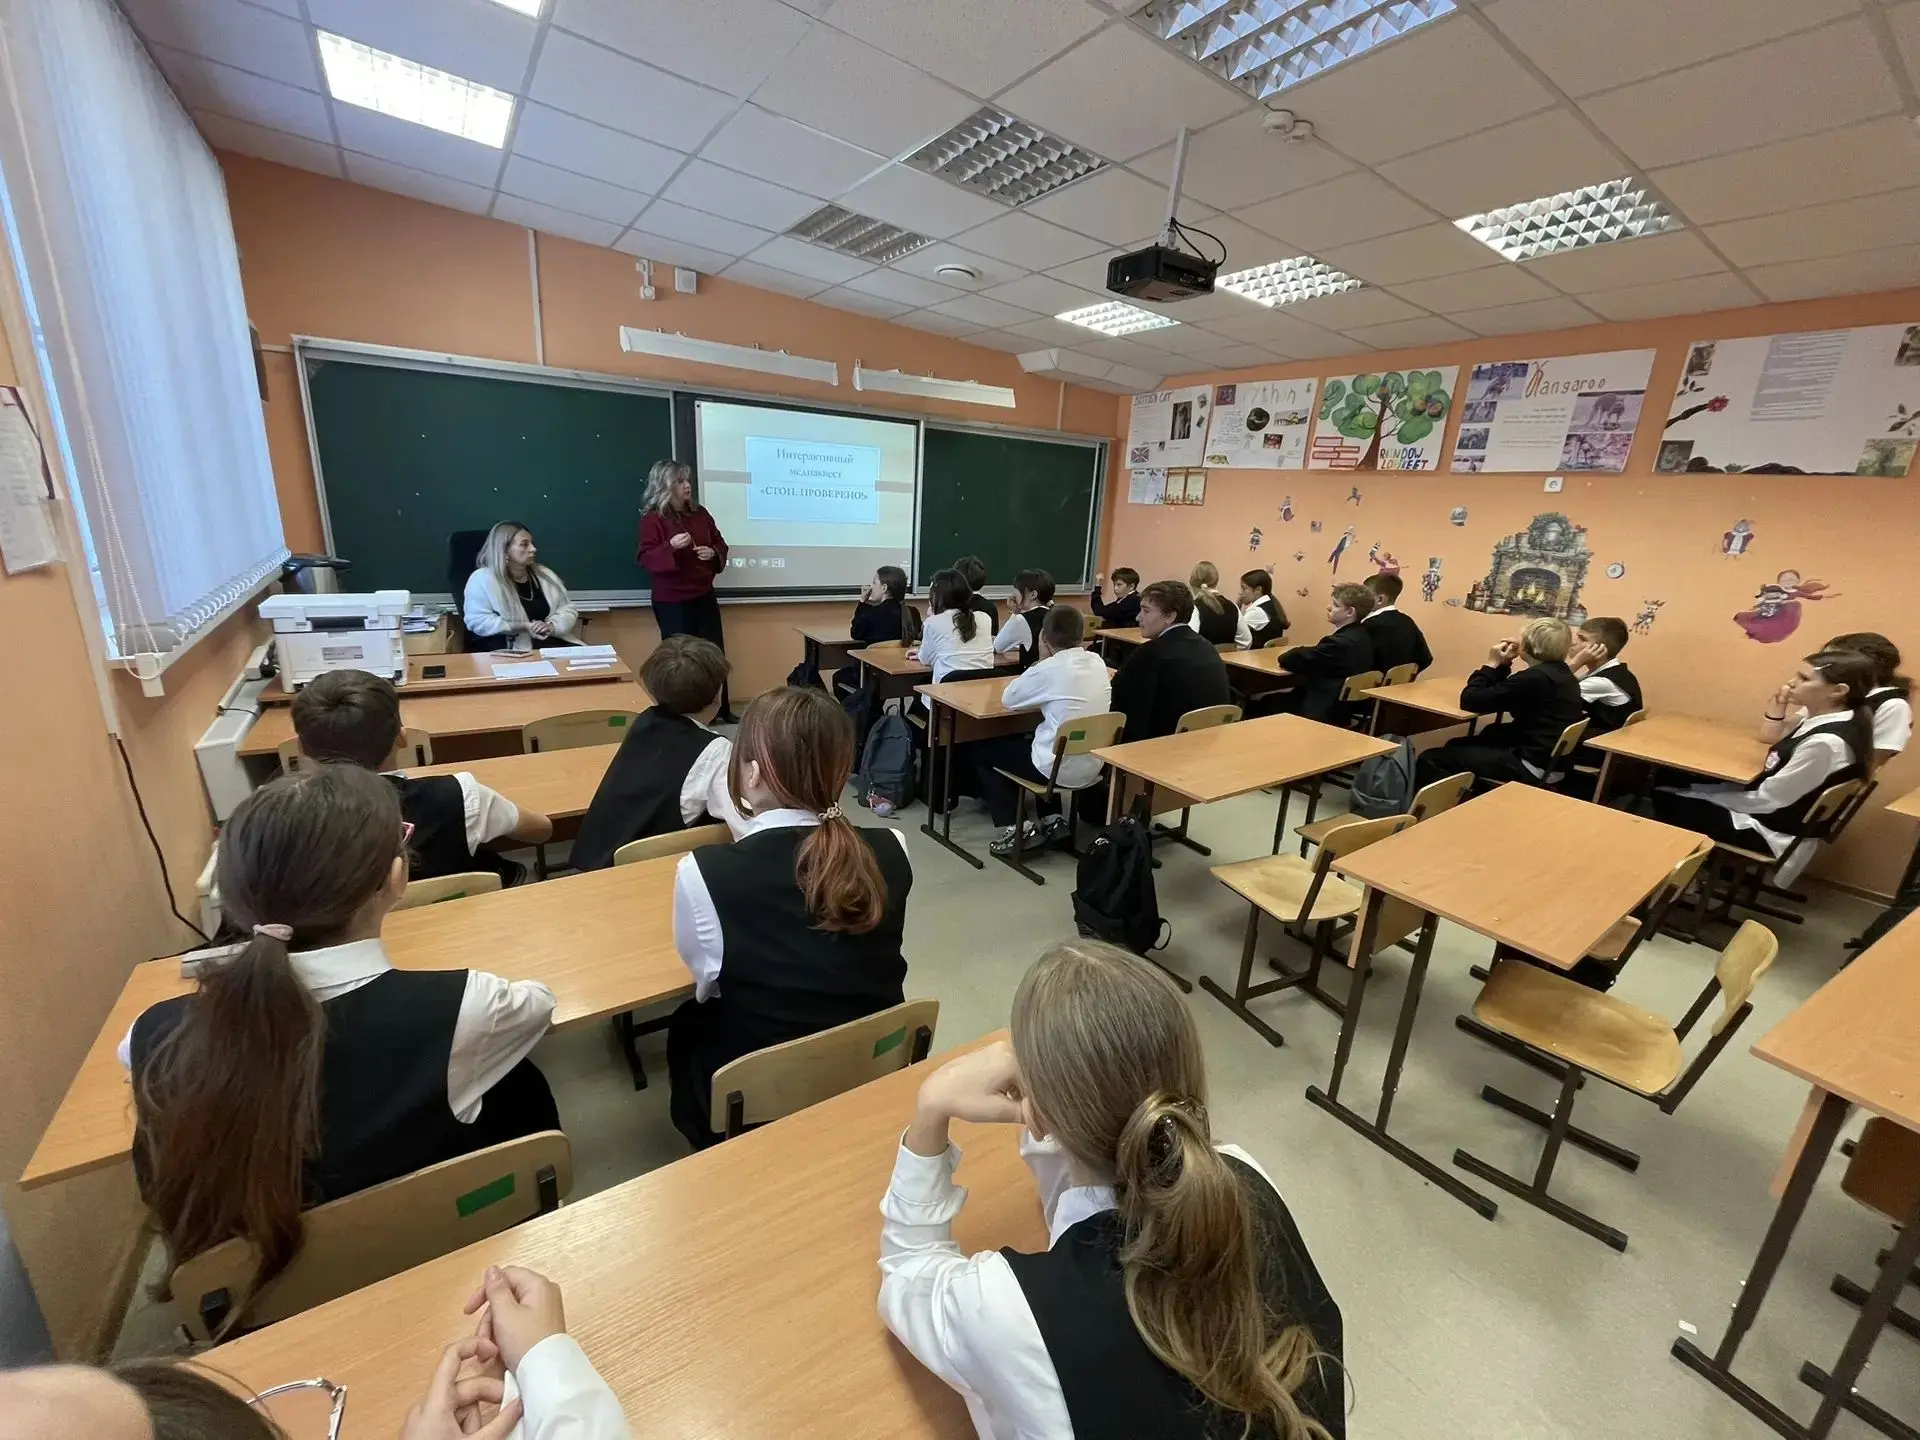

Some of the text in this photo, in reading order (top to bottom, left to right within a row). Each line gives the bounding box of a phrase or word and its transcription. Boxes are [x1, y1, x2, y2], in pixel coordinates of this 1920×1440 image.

[1525, 361, 1606, 398] Kangaroo
[1241, 384, 1297, 406] ythn
[776, 448, 854, 464] Интерактивный
[1381, 459, 1429, 469] LOIKEET
[789, 468, 842, 478] медиаквест
